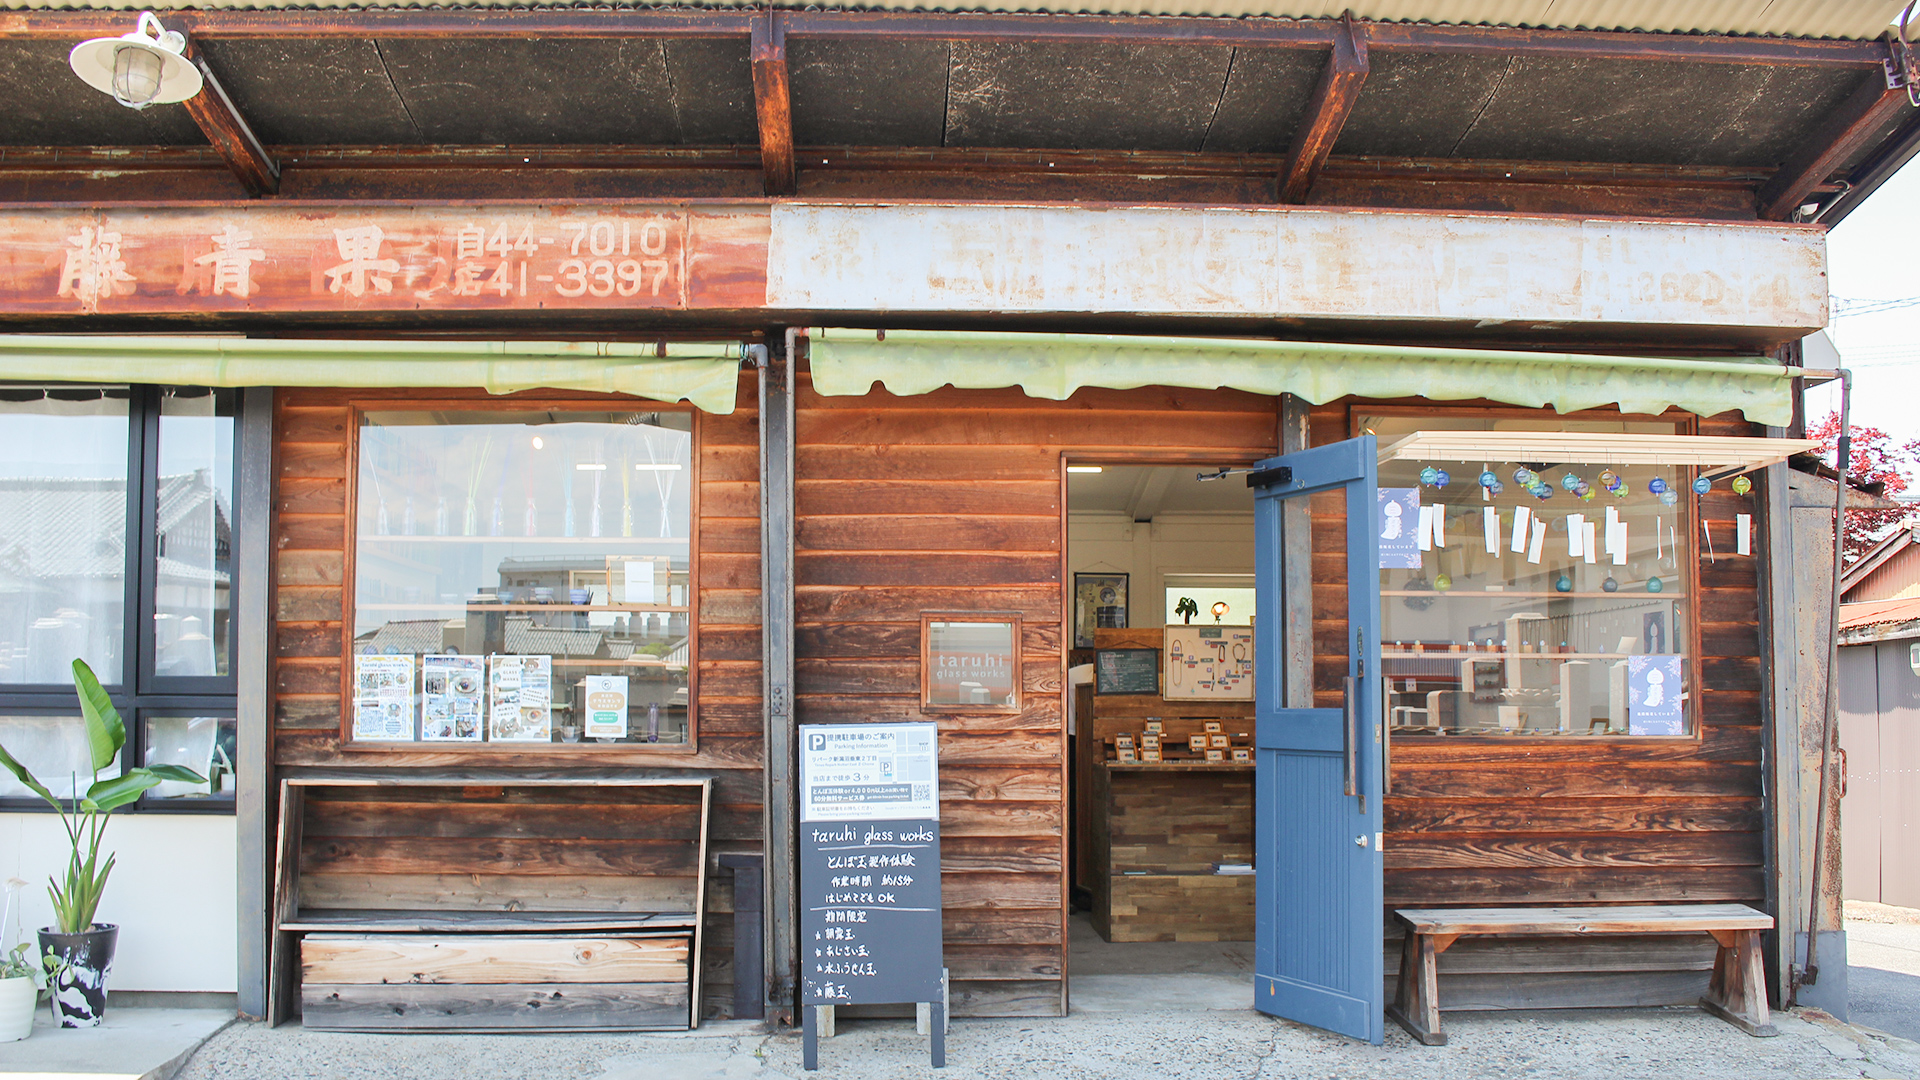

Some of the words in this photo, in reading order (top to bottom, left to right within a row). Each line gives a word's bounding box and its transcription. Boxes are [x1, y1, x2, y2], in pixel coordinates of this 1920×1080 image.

[939, 653, 1003, 667] taruhi
[936, 670, 967, 679] glass
[971, 670, 1005, 678] works
[812, 825, 856, 842] taruhi
[864, 825, 893, 845] glass
[900, 825, 934, 842] works
[878, 893, 896, 903] OK
